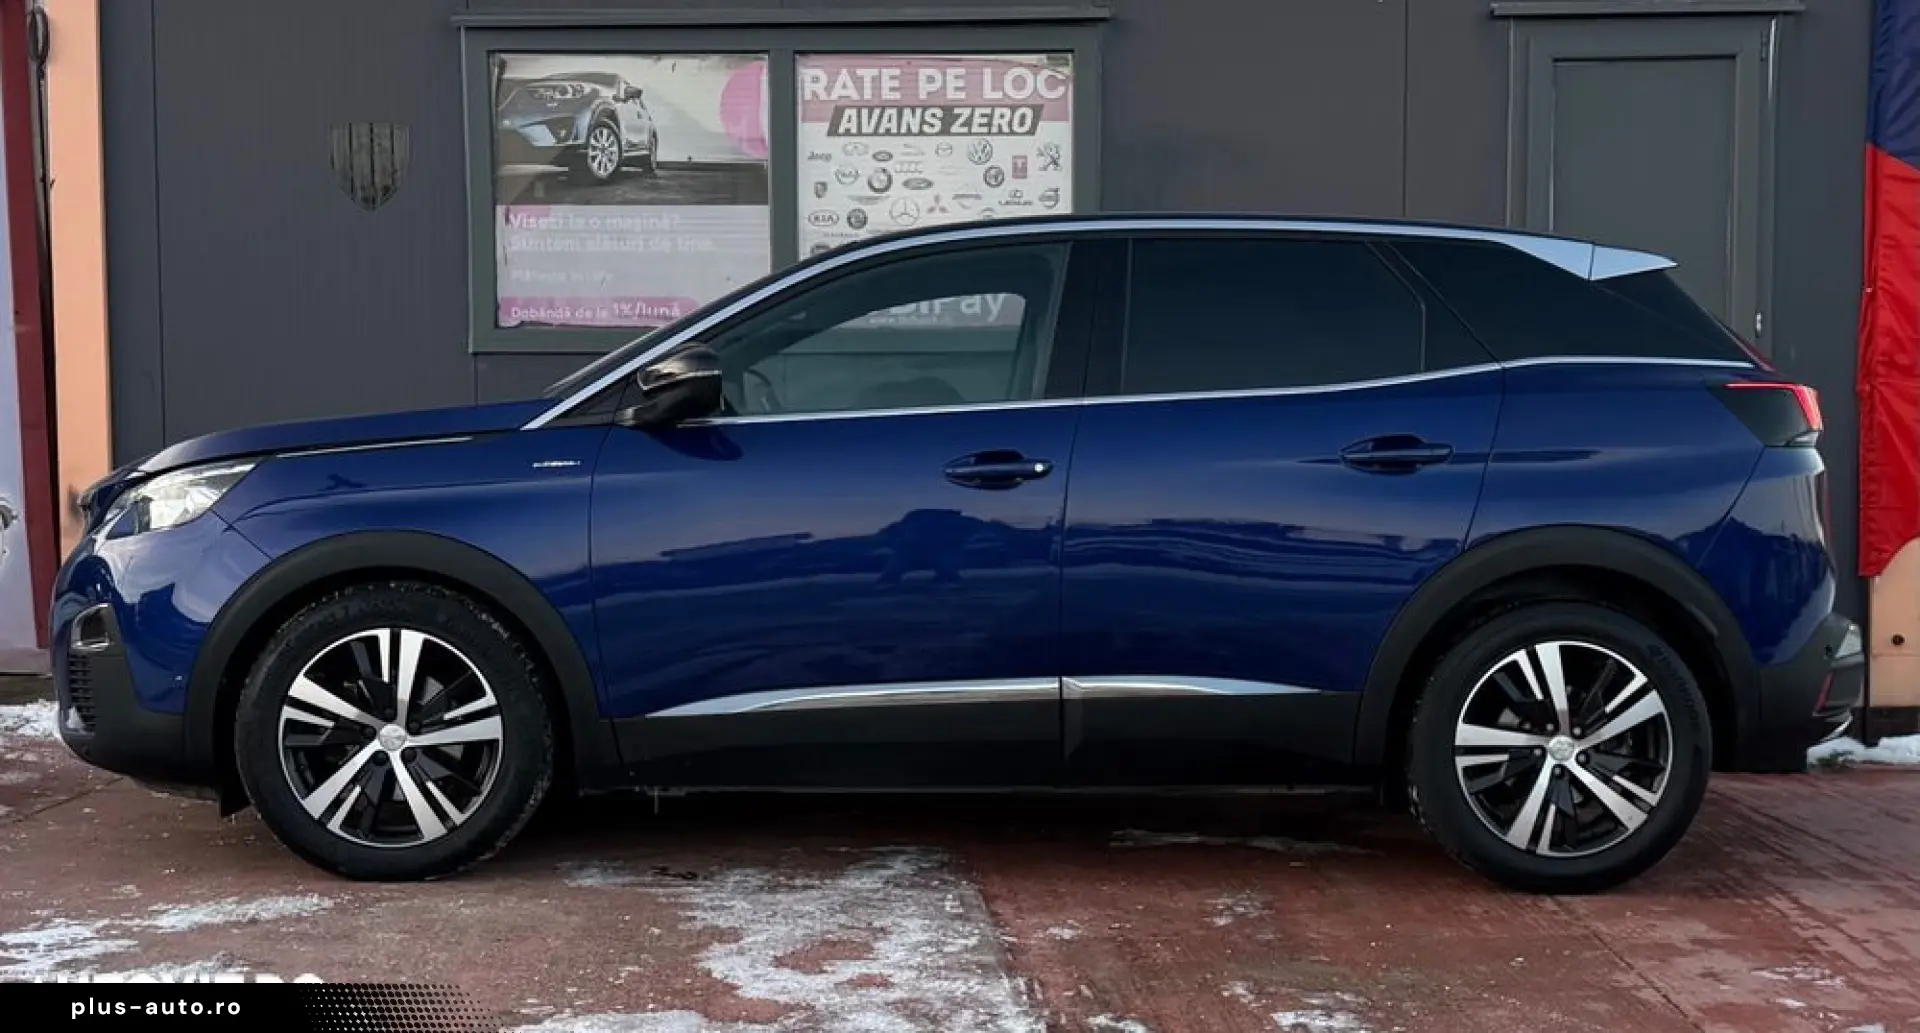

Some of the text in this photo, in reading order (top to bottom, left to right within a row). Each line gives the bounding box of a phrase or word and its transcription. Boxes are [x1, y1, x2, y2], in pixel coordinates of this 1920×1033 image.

[802, 66, 1066, 100] RATE PE LOC
[837, 106, 1033, 133] AVANS ZERO
